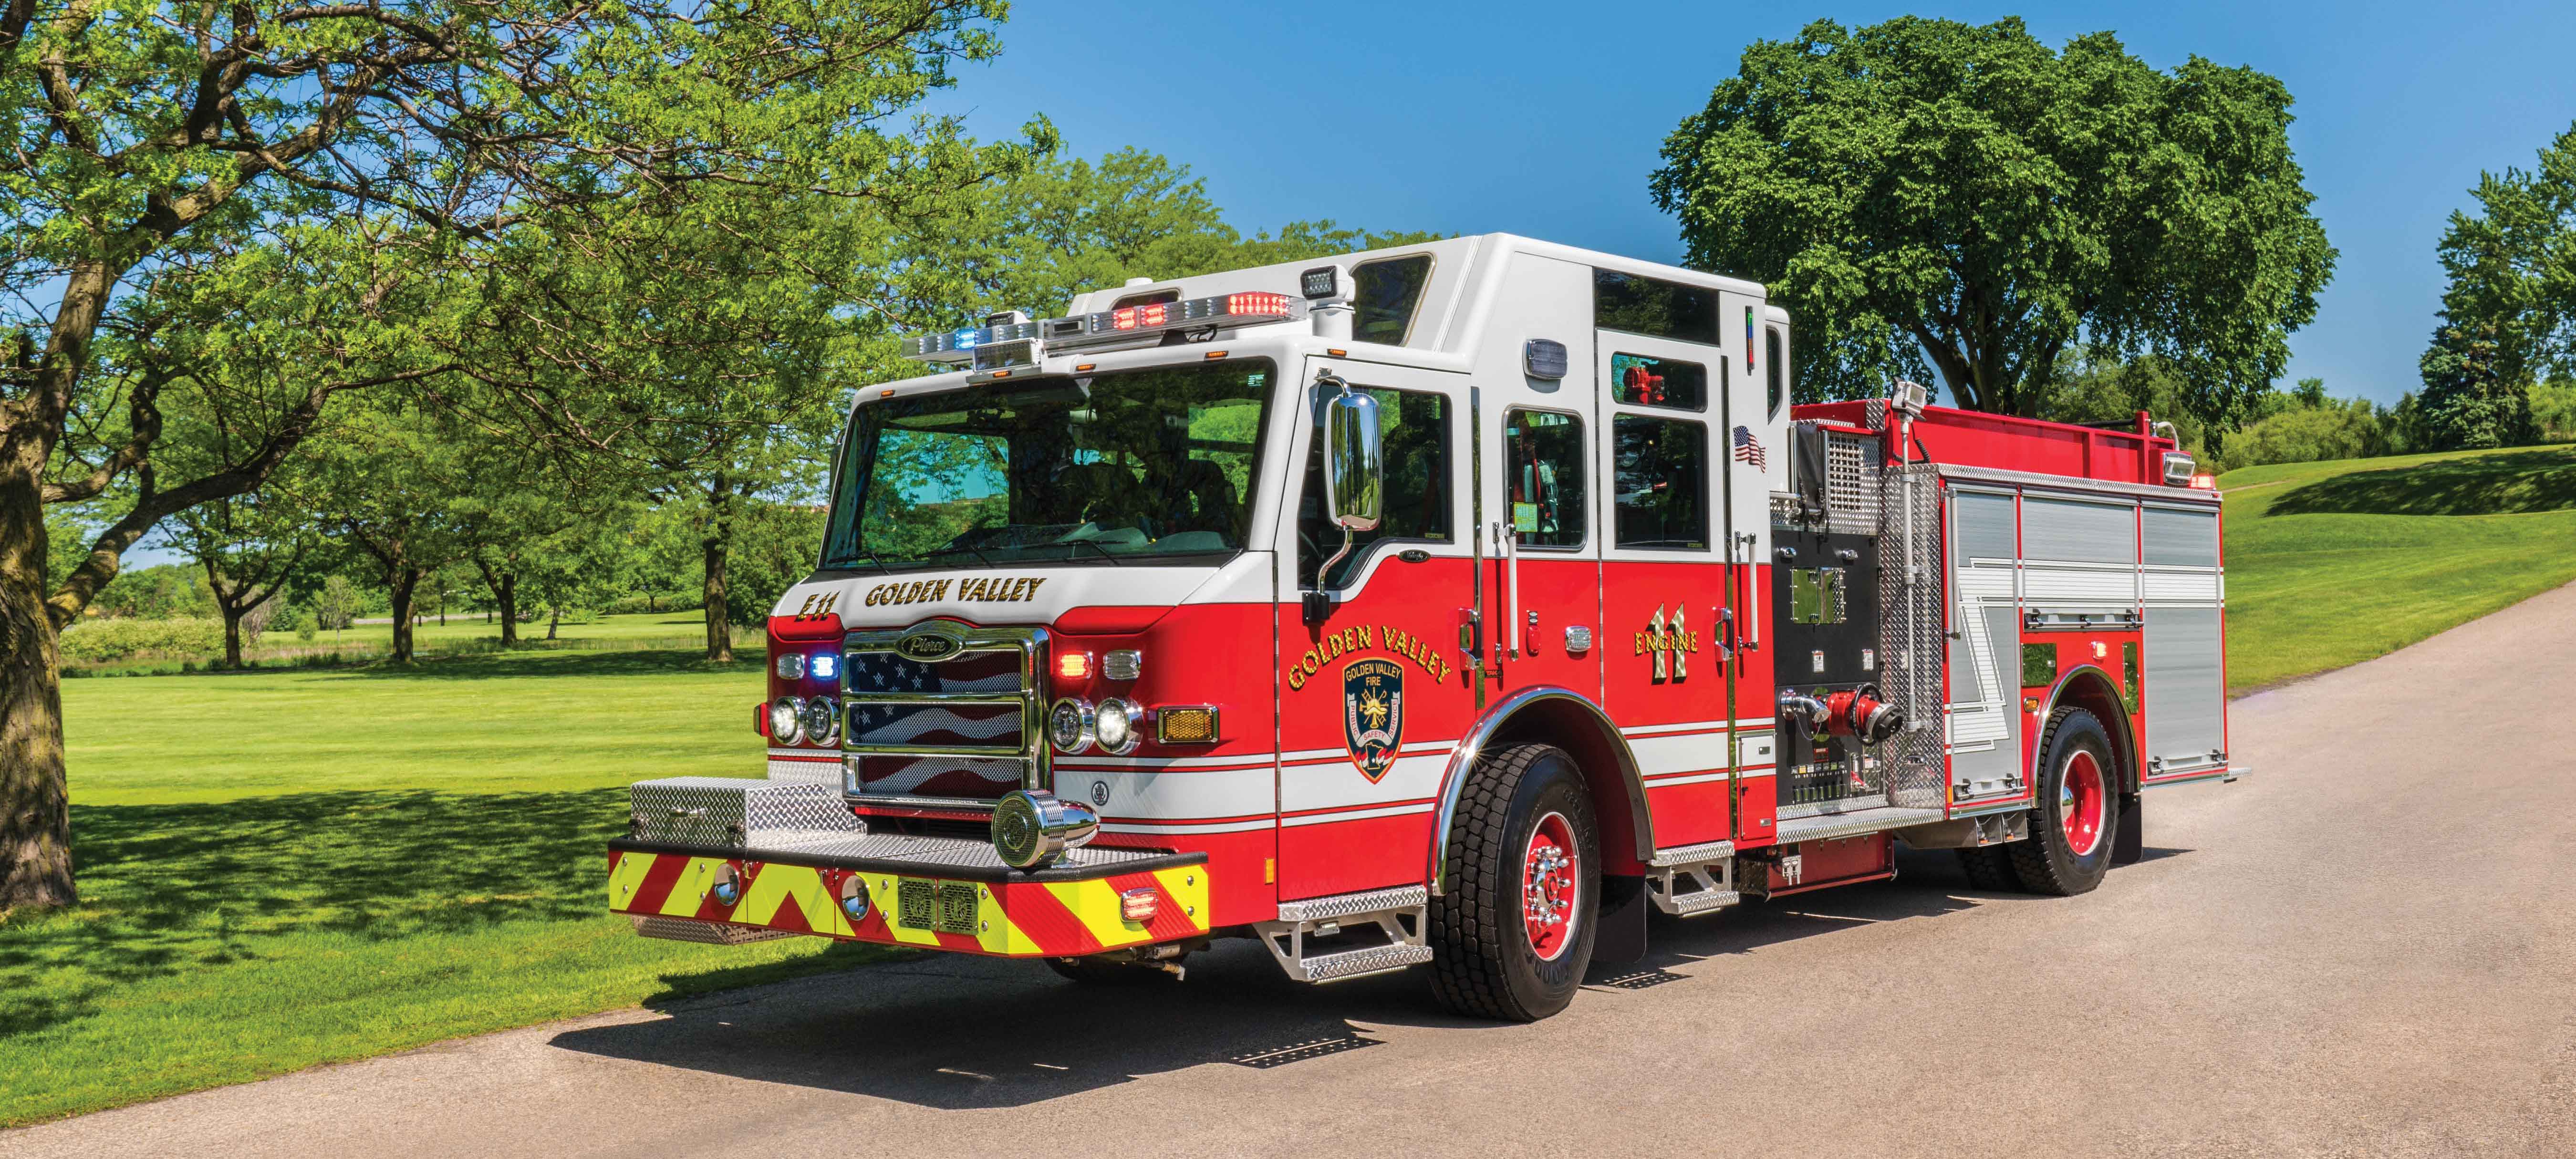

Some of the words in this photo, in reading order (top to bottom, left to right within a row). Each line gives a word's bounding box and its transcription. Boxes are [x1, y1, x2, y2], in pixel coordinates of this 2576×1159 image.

[865, 579, 954, 607] GOLDEN
[957, 578, 1047, 602] VALLEY
[909, 637, 946, 655] Pierce
[1634, 630, 1699, 656] ENGINE
[1645, 601, 1687, 685] 11
[1288, 625, 1372, 691] GOLDEN
[1381, 625, 1452, 684] VALLEY
[1346, 663, 1374, 682] GOLDEN
[1375, 663, 1401, 679] VALLEY
[1366, 676, 1381, 686] FIRE
[1350, 704, 1359, 736] PUBLIC
[1389, 700, 1397, 735] SERVICE
[1363, 731, 1385, 741] SAFETY
